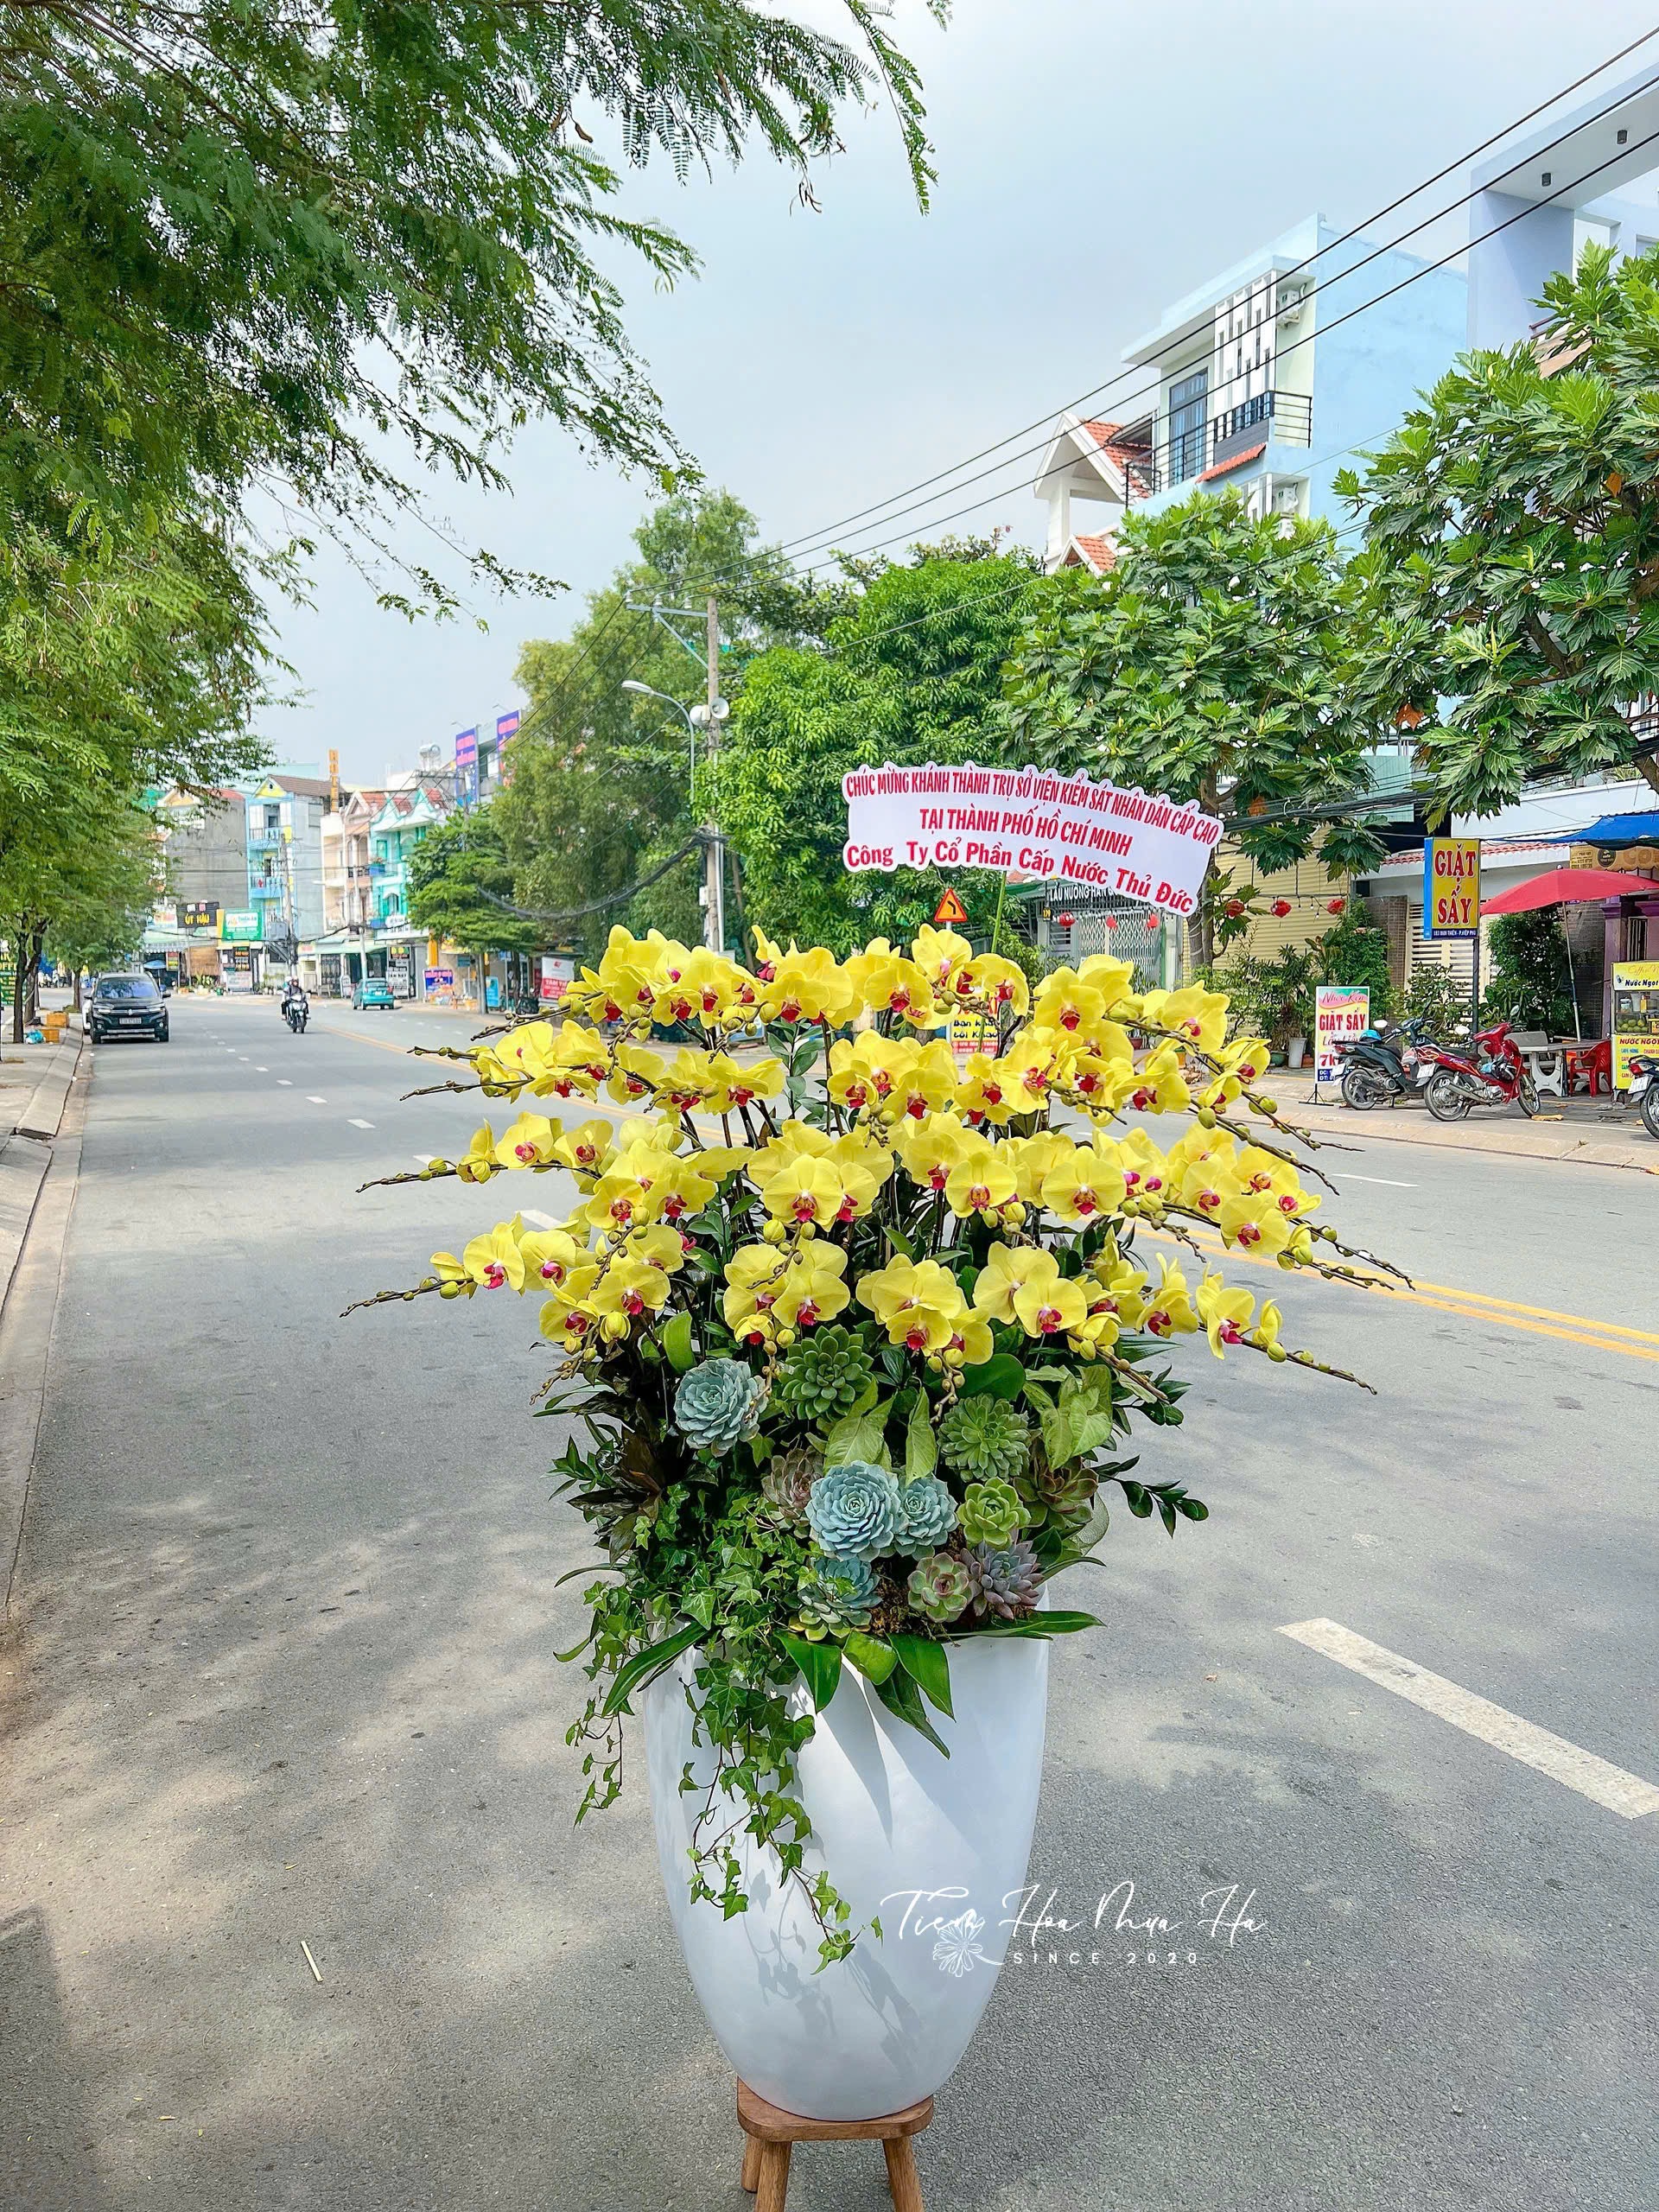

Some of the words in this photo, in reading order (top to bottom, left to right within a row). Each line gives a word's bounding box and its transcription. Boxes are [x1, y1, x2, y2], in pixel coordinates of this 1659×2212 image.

[846, 768, 875, 798] CHÚC
[911, 765, 950, 793] KHÁNH
[952, 766, 990, 794] THÀNH
[993, 773, 1015, 801] TRỤ
[1015, 768, 1033, 798] SỞ
[1033, 773, 1060, 805] VIỆN
[1059, 771, 1090, 808] KIỂM
[1090, 784, 1114, 813] SÁT
[1110, 791, 1147, 822] NHÂN
[1143, 798, 1173, 830] DÂN
[1170, 804, 1196, 836] CẤP
[1192, 819, 1219, 845] CAO
[919, 808, 944, 835] TẠI
[947, 803, 1000, 832] THÀNH
[1001, 804, 1039, 836] PHỐ
[1034, 808, 1062, 840] HỒ
[1060, 819, 1091, 848] CHÍ
[1088, 827, 1134, 856] MINH
[847, 845, 893, 868] Công
[906, 841, 929, 865] Ty
[935, 836, 963, 862] Cổ
[966, 842, 1012, 865] Phần
[1019, 847, 1055, 876] Cấp
[1060, 855, 1109, 886] Nước
[1116, 868, 1152, 898] Thủ
[1154, 881, 1193, 913] Đức
[1434, 843, 1476, 883] GIẶT
[1438, 885, 1472, 924] SẤY
[1346, 1007, 1365, 1030] SẤY
